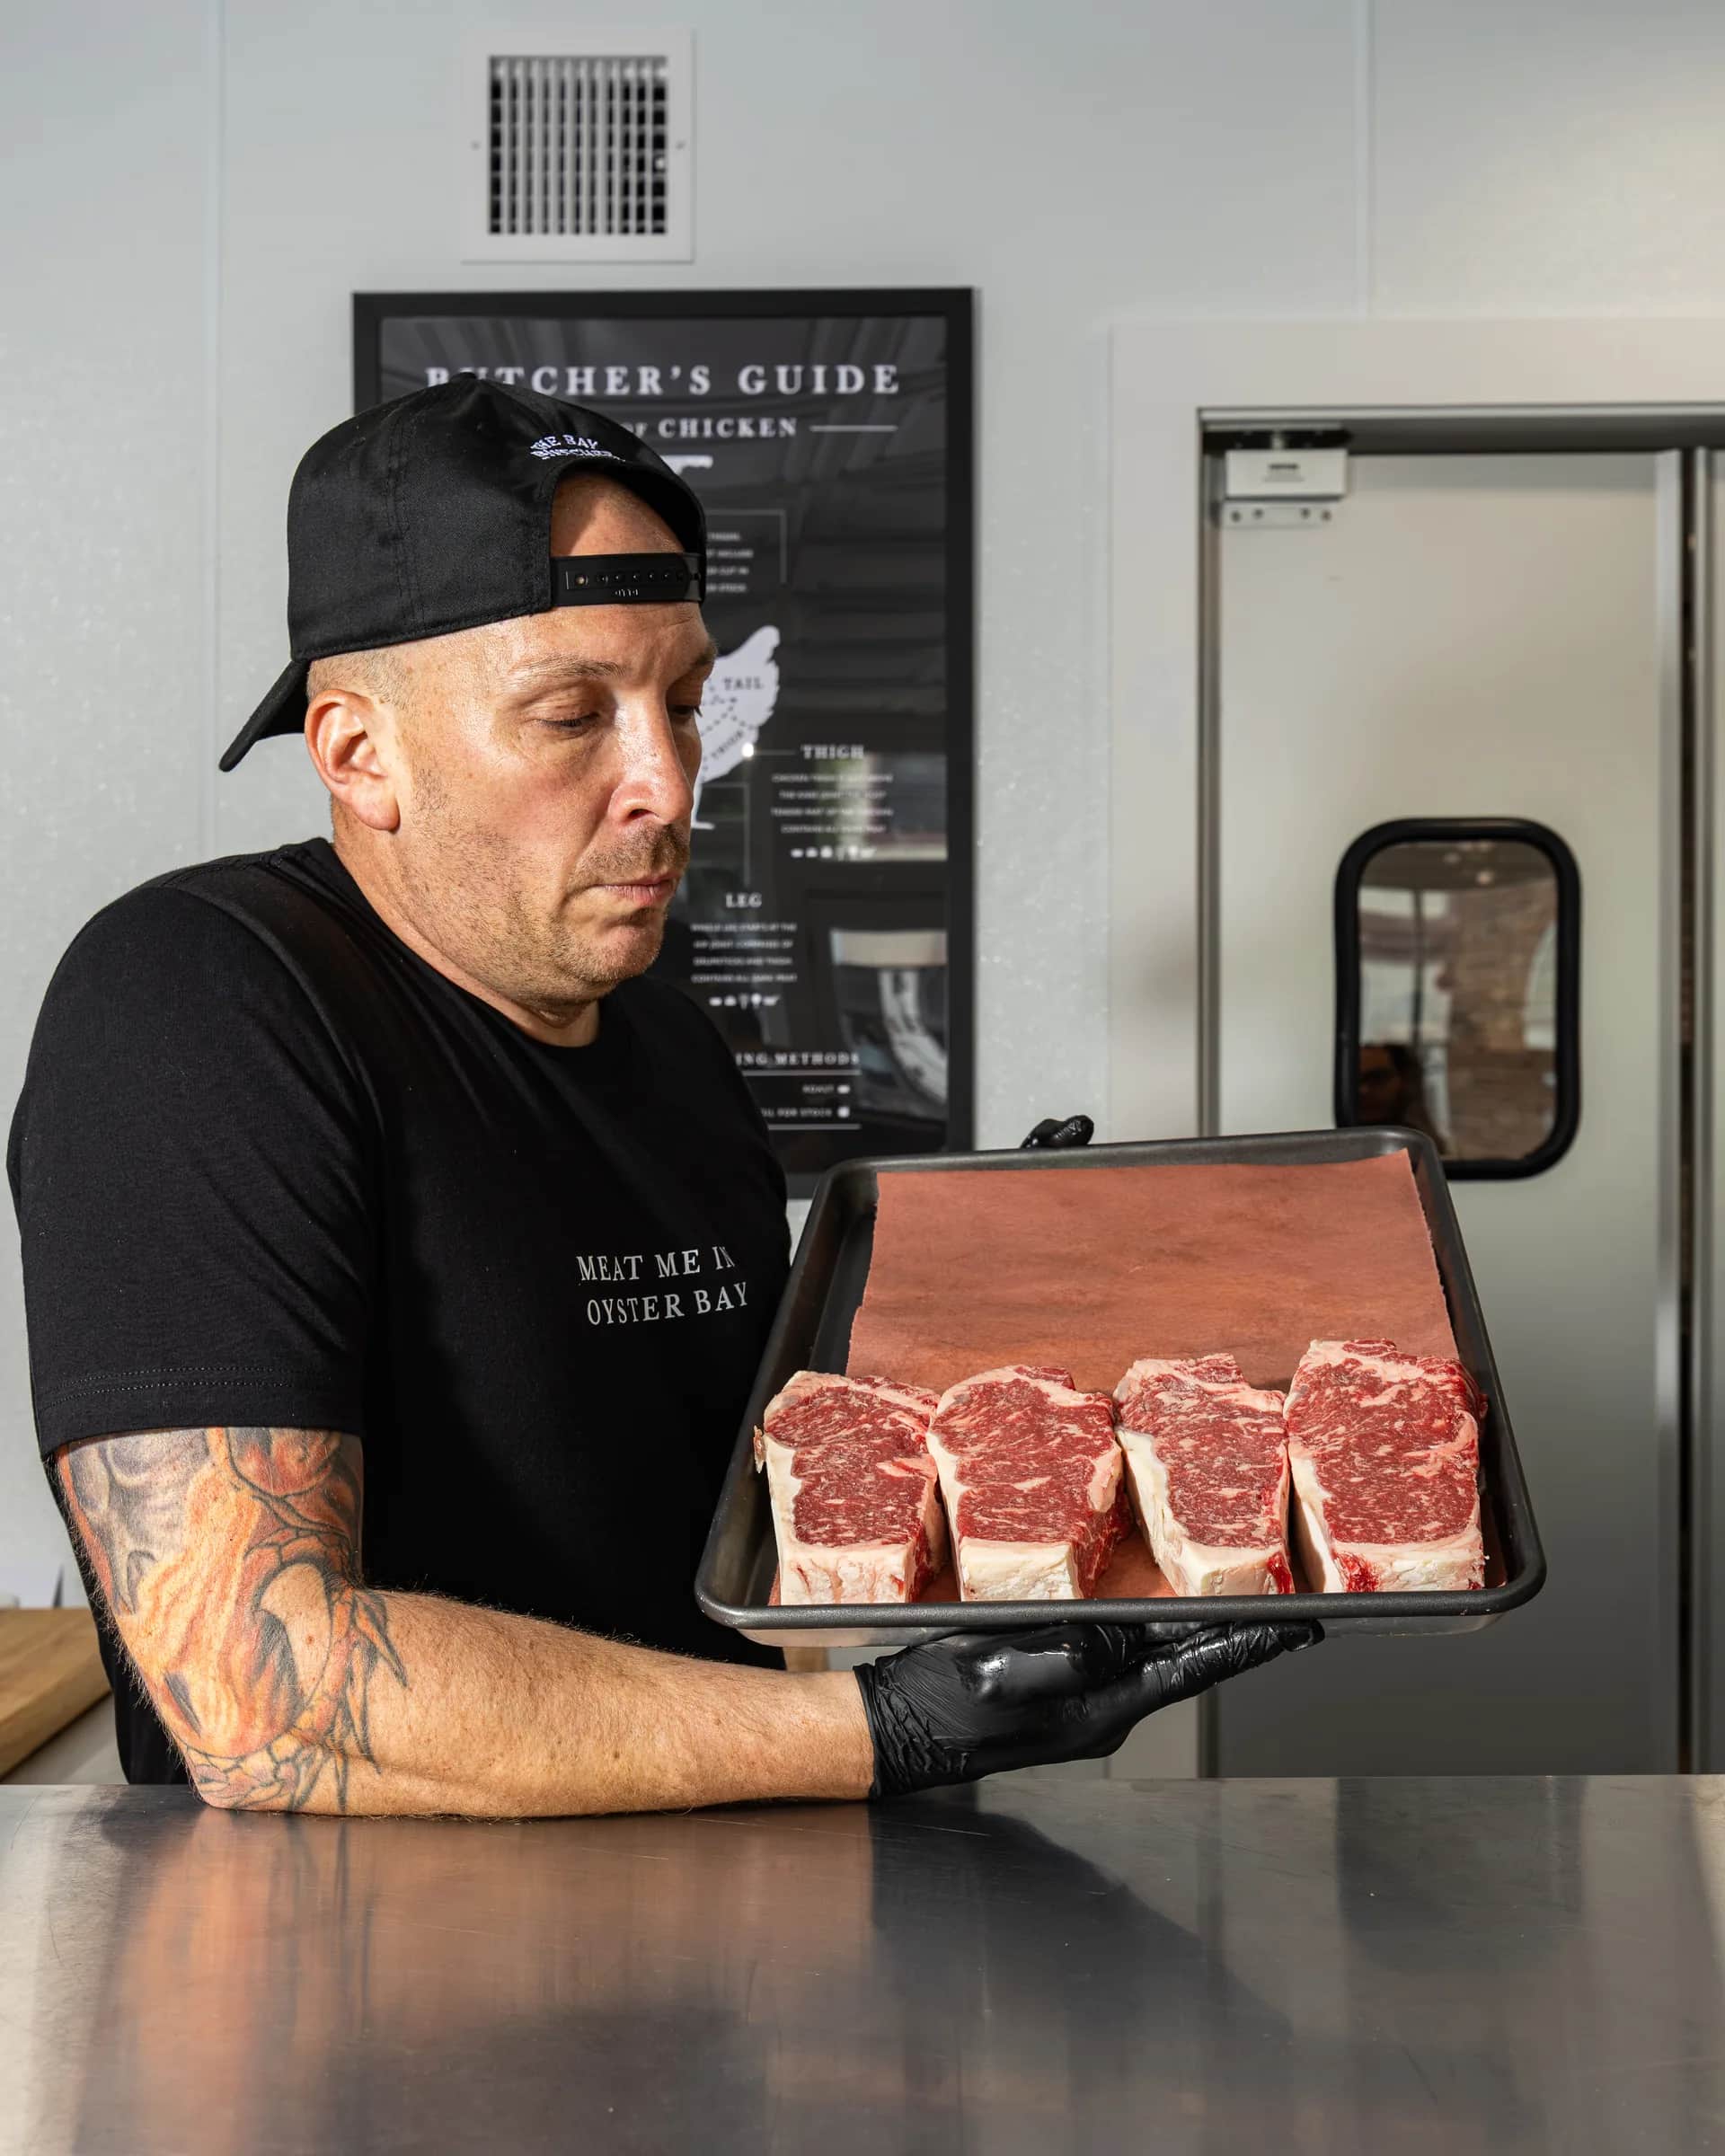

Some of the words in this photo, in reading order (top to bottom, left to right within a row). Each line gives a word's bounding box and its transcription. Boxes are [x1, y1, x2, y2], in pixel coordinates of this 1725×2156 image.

[738, 365, 898, 394] GUIDE
[658, 418, 797, 438] CHICKEN
[562, 434, 598, 449] BAY
[724, 676, 763, 690] TAIL
[801, 744, 864, 759] THIGH
[725, 892, 763, 908] LEG
[774, 1052, 860, 1065] METHODS
[576, 1255, 643, 1281] MEAT
[654, 1249, 701, 1278] ME
[587, 1294, 685, 1325] OYSTER
[693, 1282, 748, 1314] BAY
